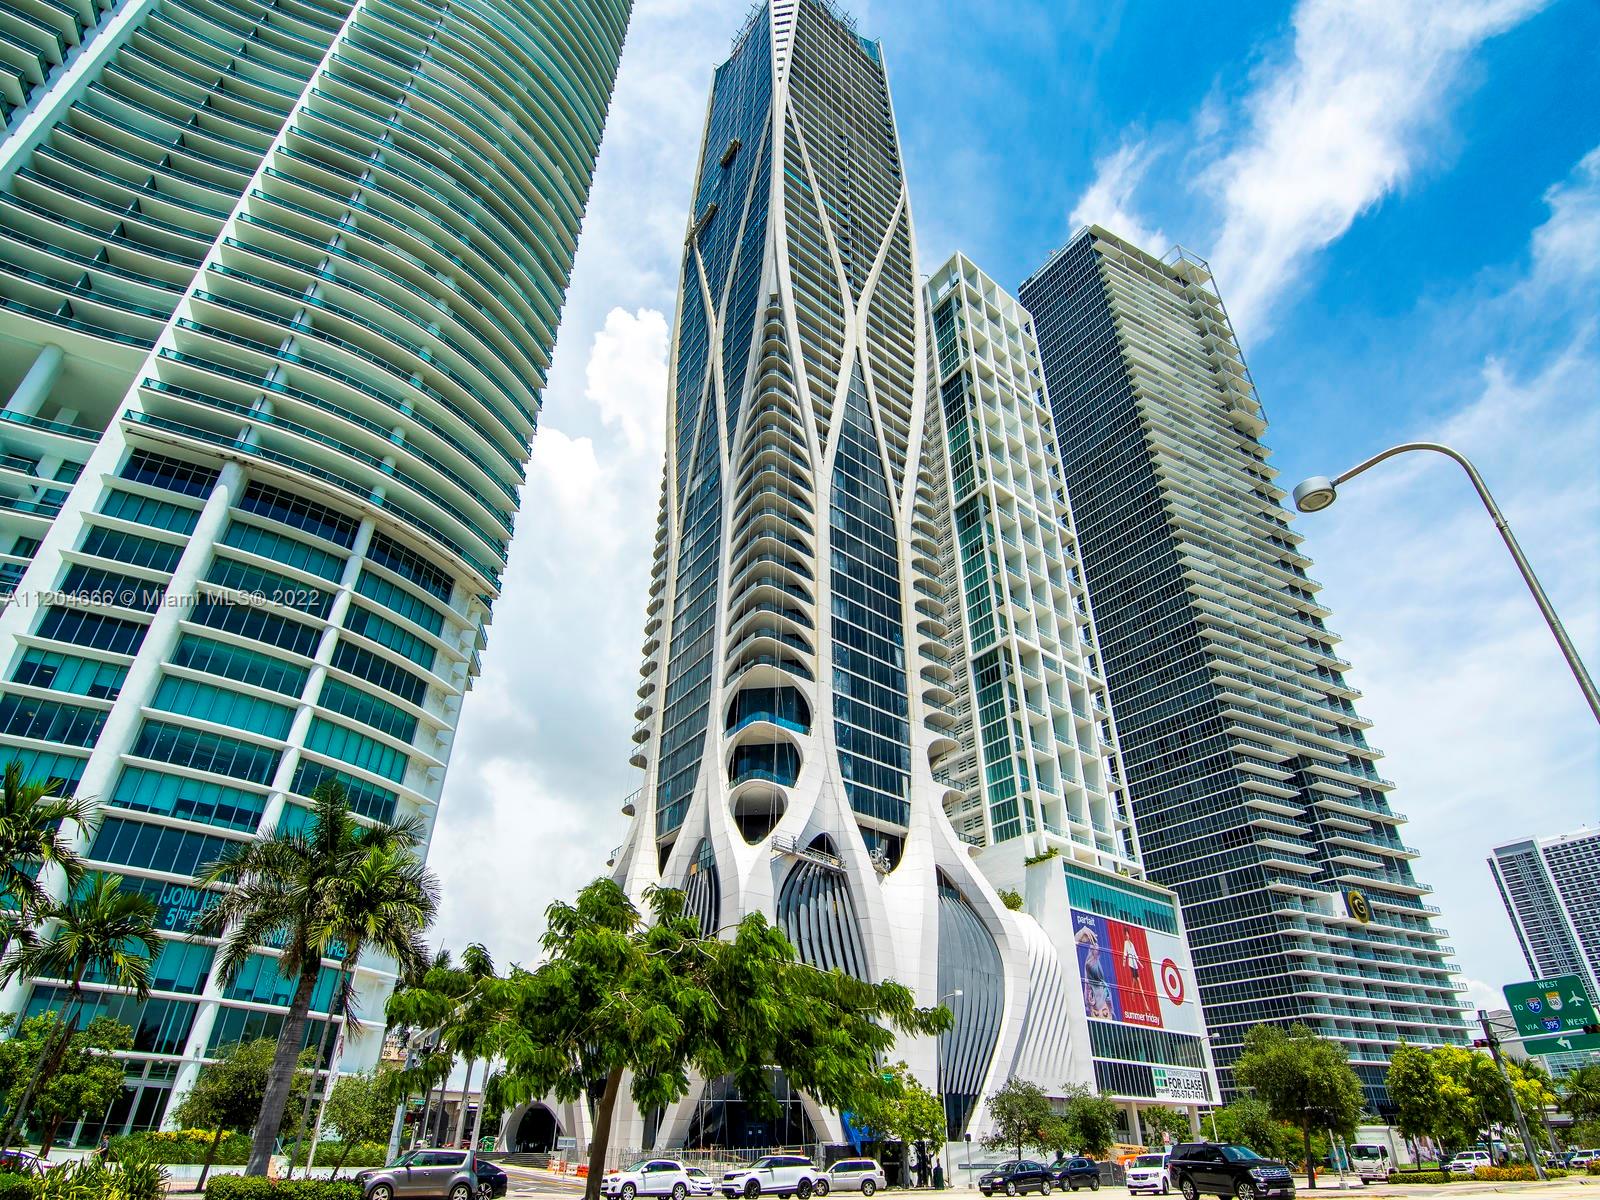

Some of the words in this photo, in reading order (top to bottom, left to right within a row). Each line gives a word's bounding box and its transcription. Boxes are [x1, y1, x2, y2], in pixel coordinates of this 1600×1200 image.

[163, 886, 200, 908] JOIN
[1537, 980, 1558, 989] WEST
[1528, 1001, 1540, 1010] 95
[1124, 1010, 1146, 1021] summer
[1525, 1023, 1539, 1031] VIA
[1545, 1021, 1559, 1030] 395
[1566, 1018, 1588, 1026] WEST
[1168, 1077, 1182, 1089] FOR
[1183, 1079, 1202, 1090] LEASE
